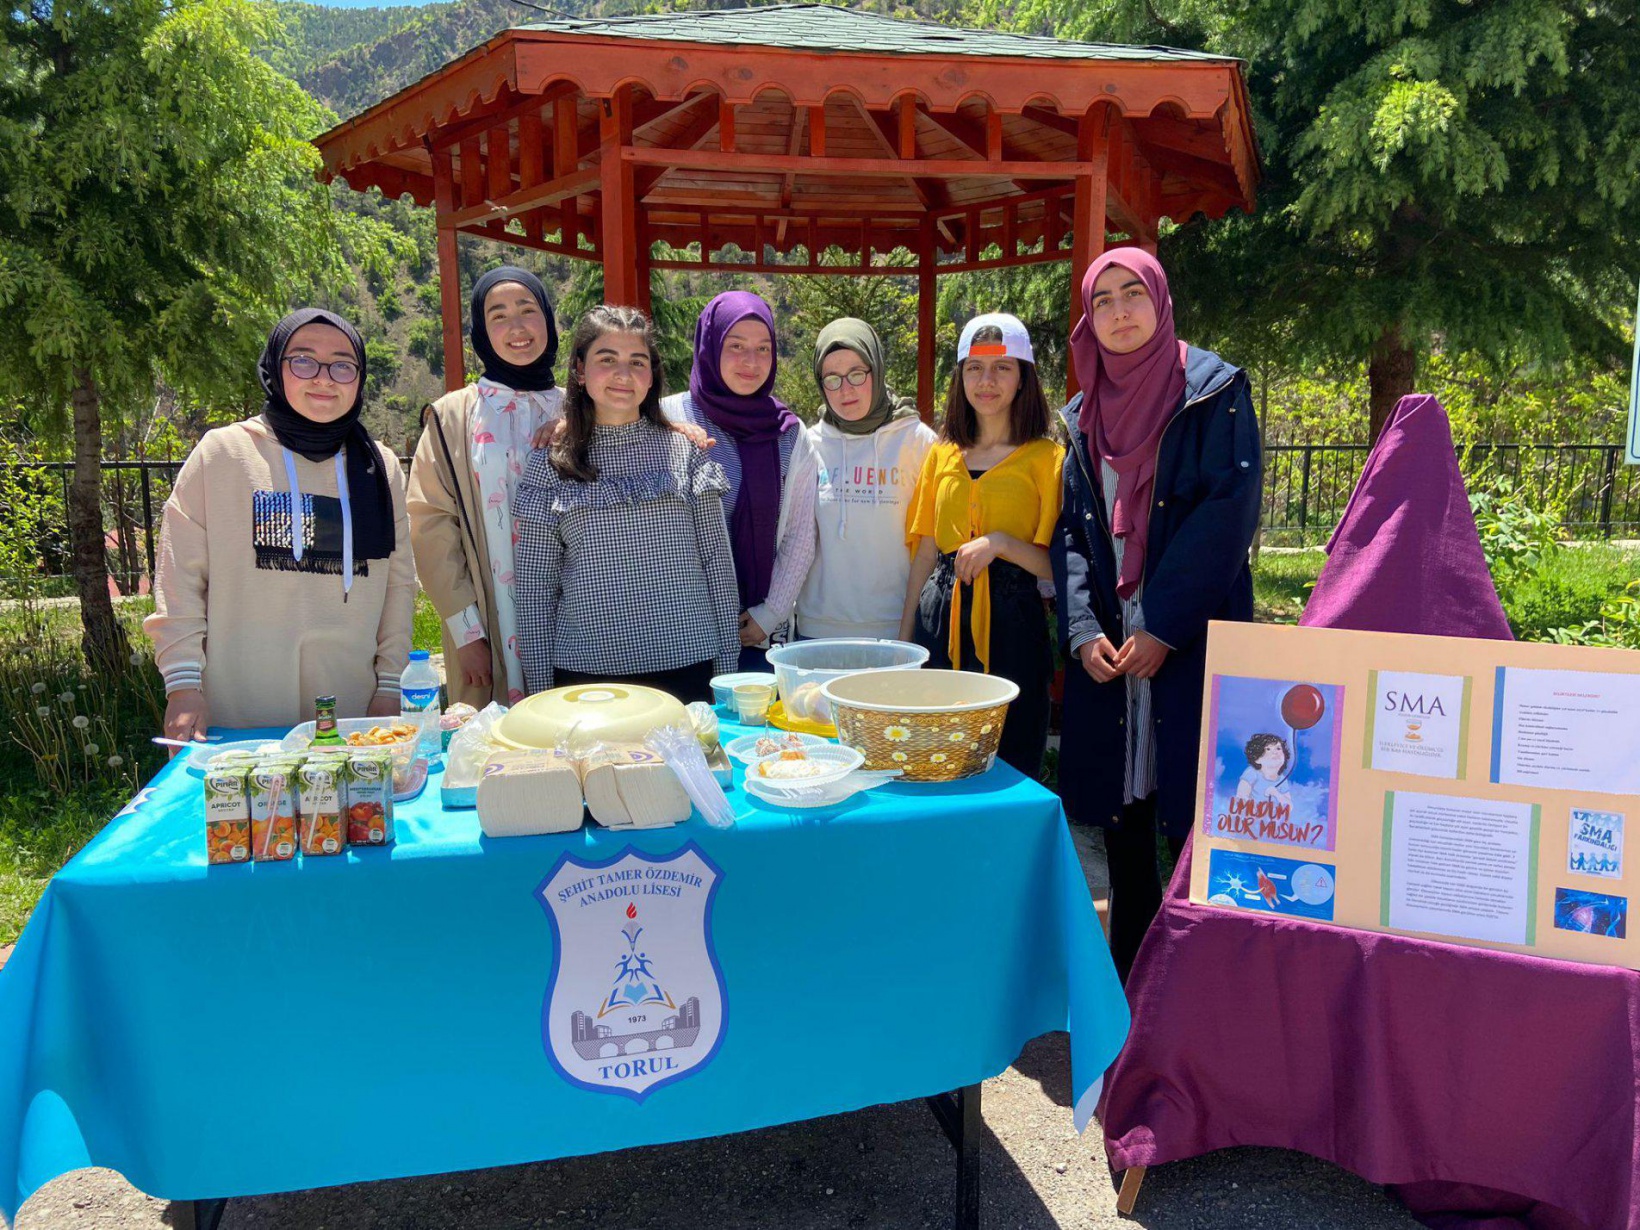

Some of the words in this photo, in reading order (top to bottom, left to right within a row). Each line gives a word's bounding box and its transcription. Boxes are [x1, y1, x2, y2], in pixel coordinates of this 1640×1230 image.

[1384, 690, 1447, 717] SMA
[1217, 814, 1258, 840] OLUR
[1581, 822, 1613, 844] SMA
[558, 878, 595, 903] ŞEHİT
[597, 869, 642, 885] TAMER
[645, 867, 703, 888] ÖZDEMİR
[579, 884, 640, 908] ANADOLU
[643, 884, 682, 898] LİSESİ
[628, 1014, 646, 1023] 1973
[598, 1056, 678, 1080] TORUL
